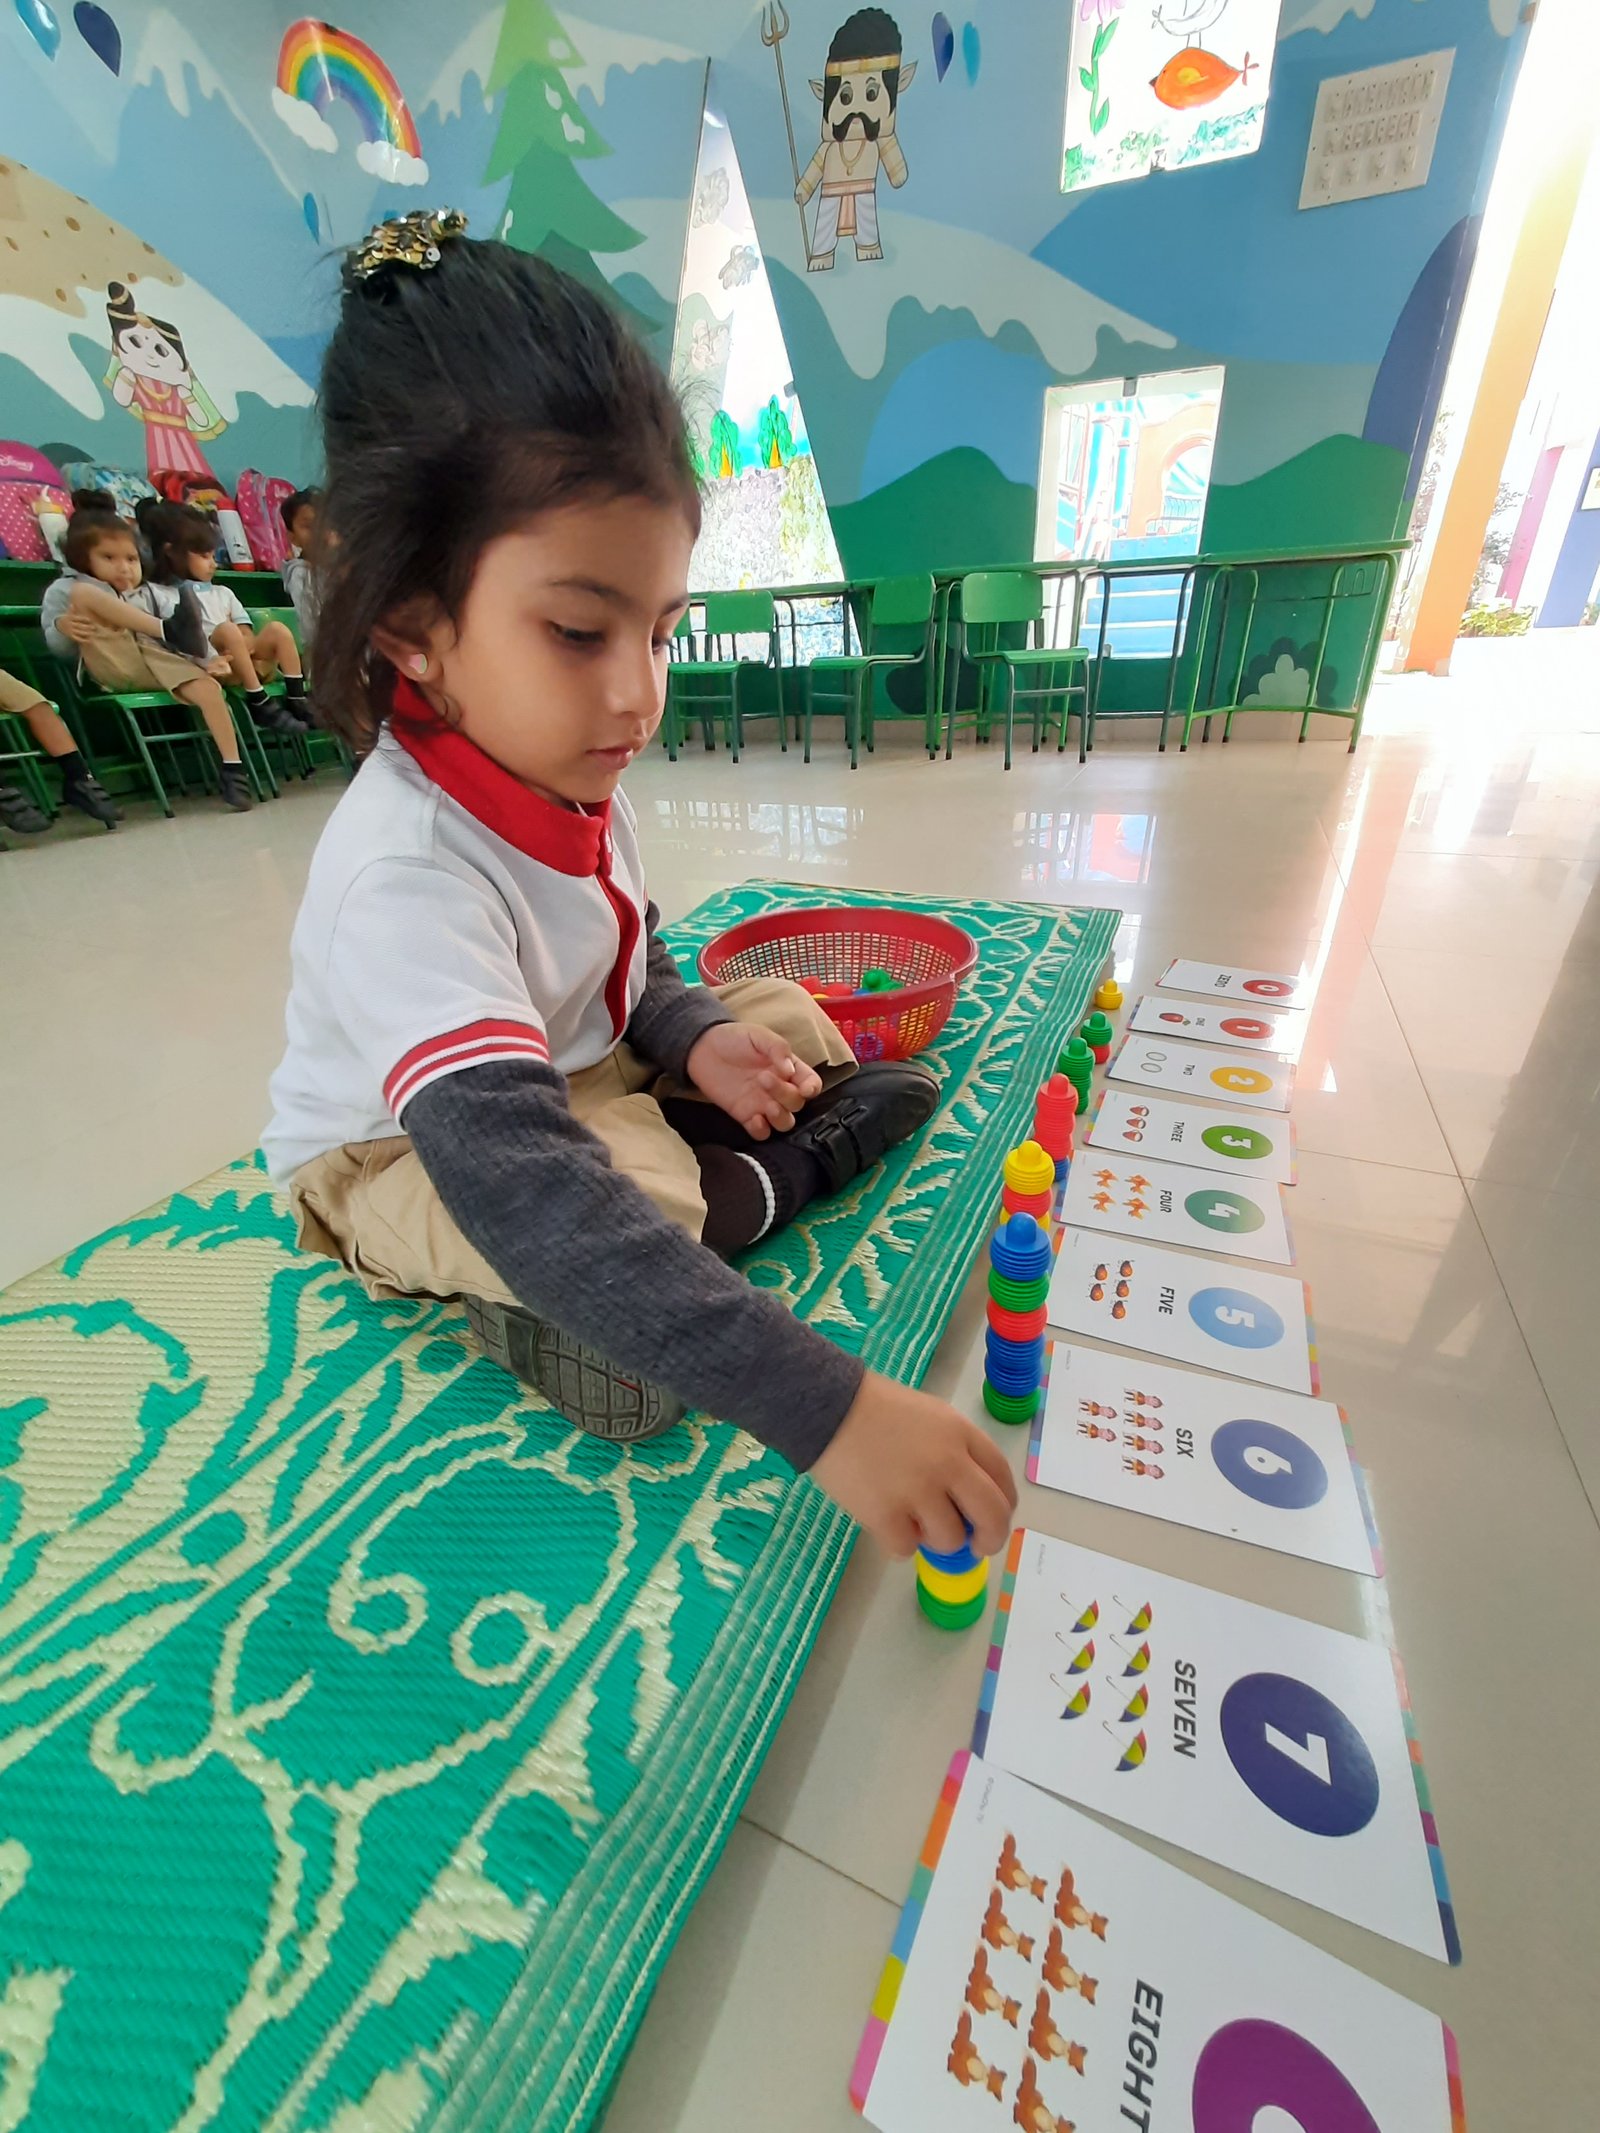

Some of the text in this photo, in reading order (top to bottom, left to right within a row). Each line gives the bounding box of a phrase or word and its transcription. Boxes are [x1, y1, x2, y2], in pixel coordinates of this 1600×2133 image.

[1214, 974, 1231, 988] ZERO
[1182, 1064, 1195, 1076] TWO
[1228, 1074, 1255, 1086] 2
[1170, 1121, 1185, 1143] THREE
[1221, 1135, 1253, 1150] 3
[1159, 1189, 1173, 1213] FOUR
[1207, 1201, 1241, 1218] 4
[1158, 1286, 1175, 1315] FIVE
[1214, 1305, 1256, 1329] 5
[1175, 1427, 1194, 1459] SIX
[1243, 1445, 1294, 1475] 6
[1173, 1659, 1197, 1759] SEVEN
[1263, 1722, 1333, 1787] 7
[1120, 1979, 1164, 2133] EIGHT
